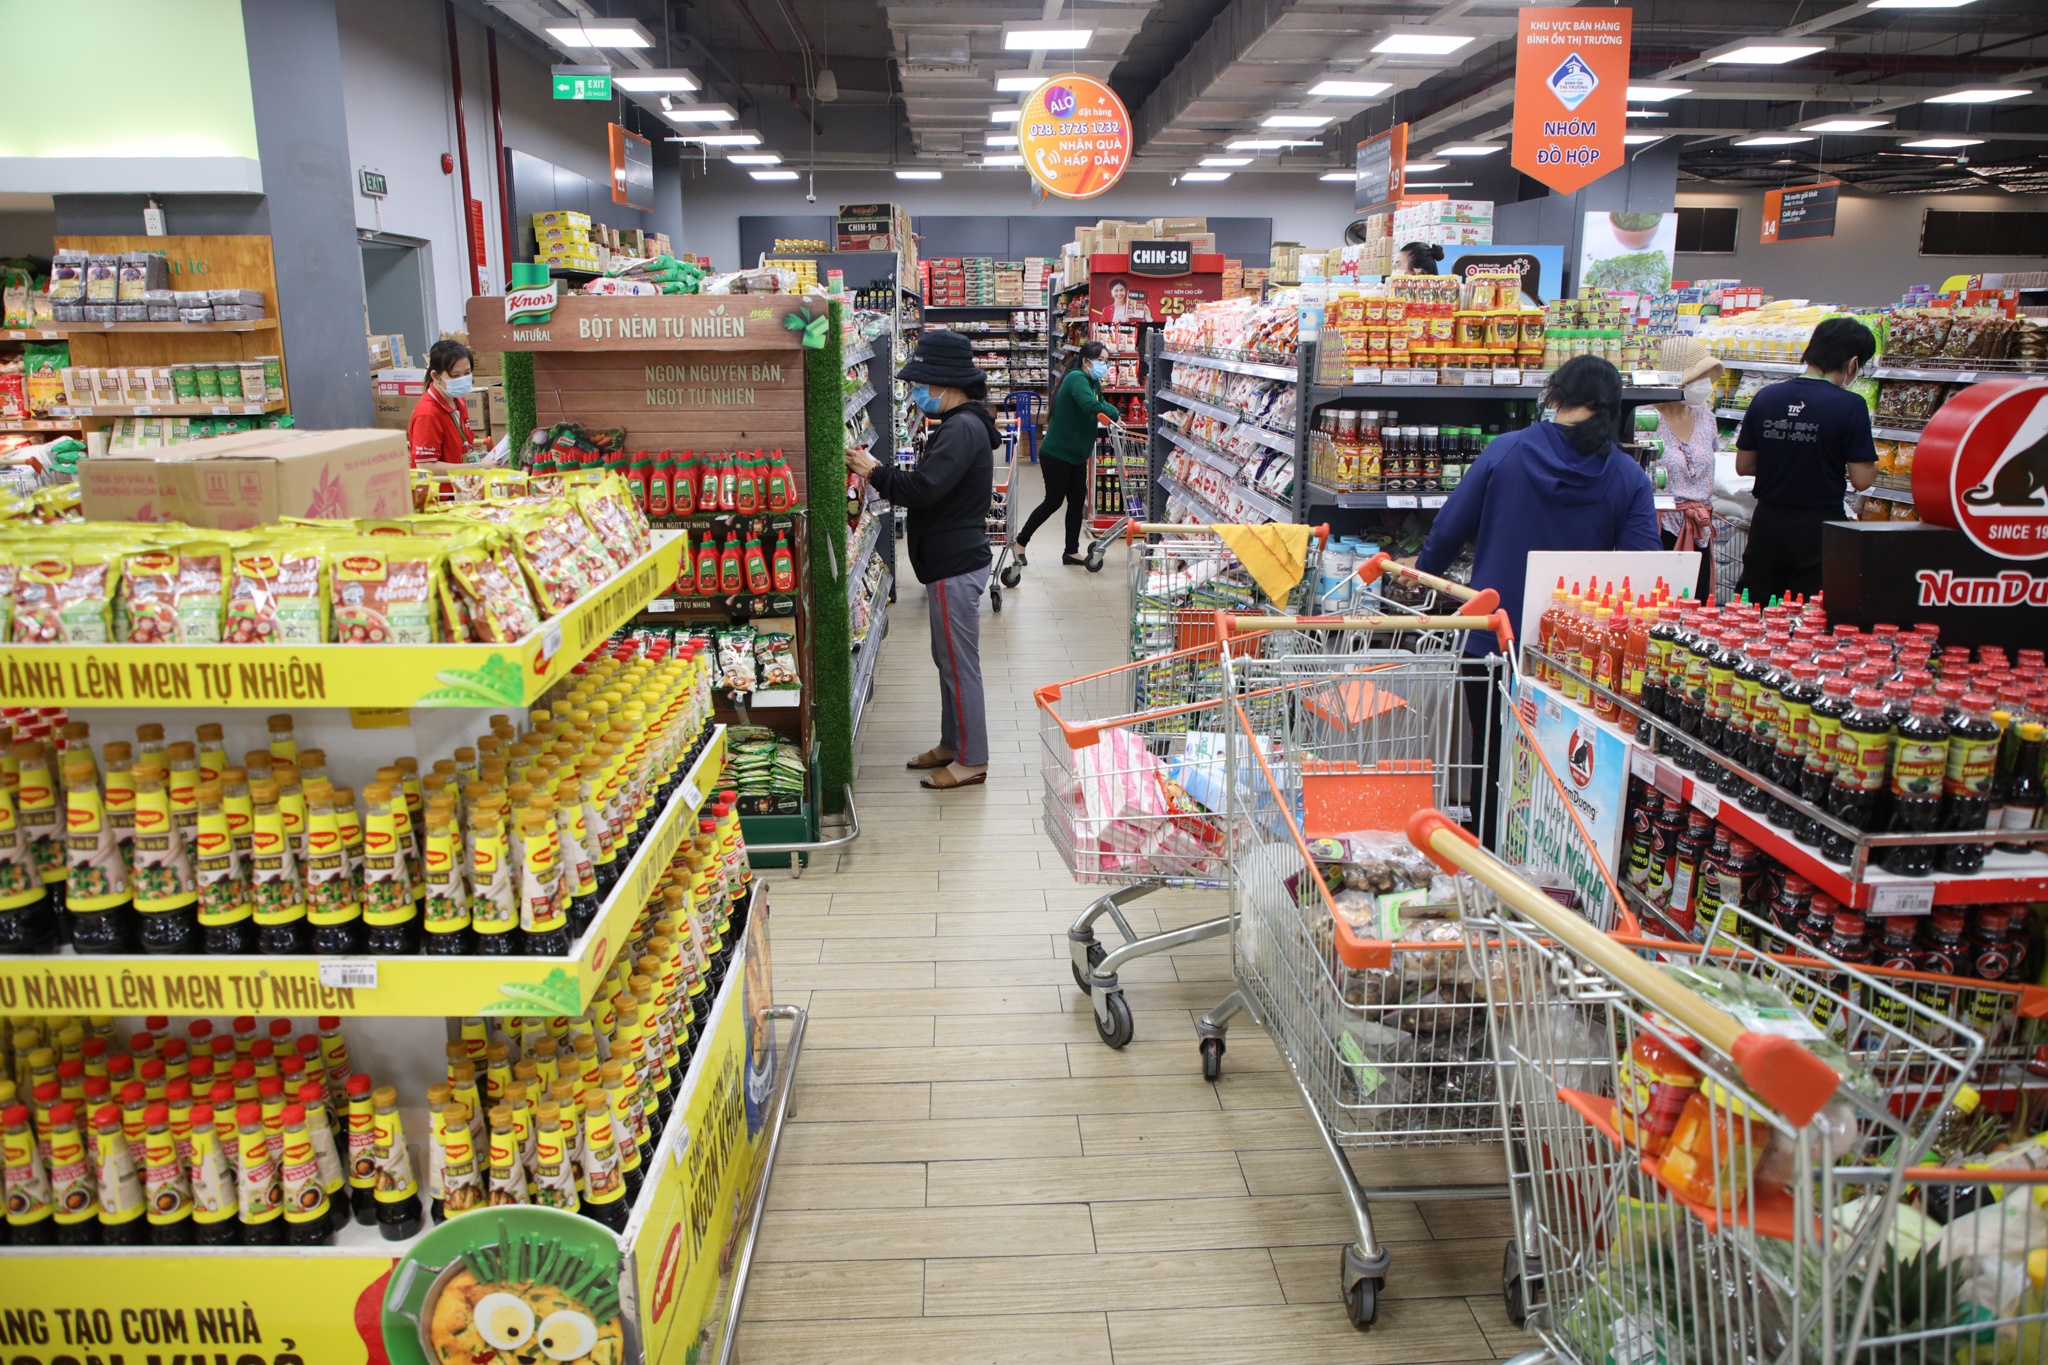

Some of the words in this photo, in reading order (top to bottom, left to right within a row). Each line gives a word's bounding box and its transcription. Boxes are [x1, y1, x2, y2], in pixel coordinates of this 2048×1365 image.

[1530, 22, 1550, 31] KHU
[1551, 21, 1571, 32] VỰC
[1573, 19, 1592, 31] BÁN
[1594, 20, 1620, 31] HÀNG
[1527, 33, 1549, 45] BÌNH
[1551, 32, 1565, 45] ỔN
[1567, 35, 1582, 46] THỊ
[1584, 34, 1622, 45] TRƯỜNG
[588, 80, 605, 89] EXIT
[1050, 96, 1074, 113] ALO
[1078, 108, 1092, 118] đặt
[1093, 108, 1112, 118] hàng
[1030, 124, 1056, 136] 028.
[1059, 122, 1088, 135] 3726
[1091, 121, 1120, 134] 1232
[1544, 117, 1597, 136] NHÓM
[1096, 137, 1122, 149] QUÀ
[1064, 150, 1088, 166] HẤP
[1094, 151, 1119, 165] DẪN
[1537, 144, 1562, 165] ĐỒ
[1566, 145, 1600, 167] HỘP
[366, 174, 386, 192] EXIT
[1390, 168, 1400, 191] 19
[848, 223, 877, 232] CHIN-SU
[1763, 220, 1776, 236] 14
[1133, 250, 1188, 264] CHIN-SU
[1465, 264, 1521, 277] Omachi
[507, 293, 555, 312] Knorr
[1160, 297, 1185, 315] 25
[749, 306, 773, 319] mới
[579, 313, 614, 342] BỘT
[618, 313, 658, 339] NÊM
[662, 314, 686, 342] TỰ
[691, 312, 746, 339] NHIÊN
[513, 329, 552, 342] NATURAL
[645, 365, 686, 383] NGON
[689, 361, 748, 382] NGUYÊN
[751, 360, 785, 384] BẢN,
[101, 378, 117, 387] ECOBA
[129, 377, 145, 386] ECOBA
[153, 377, 169, 386] ECOBA
[646, 387, 684, 409] NGỌT
[687, 386, 708, 409] TỰ
[711, 385, 755, 406] NHIÊN
[378, 405, 400, 413] Select
[1788, 404, 1802, 413] TTC
[1988, 525, 2030, 539] SINCE
[195, 662, 233, 705] TỰ
[23, 969, 103, 1010] NÀNH
[54, 1308, 114, 1352] TẠO
[121, 1307, 190, 1345] CƠM
[195, 1300, 263, 1345] NHÀ
